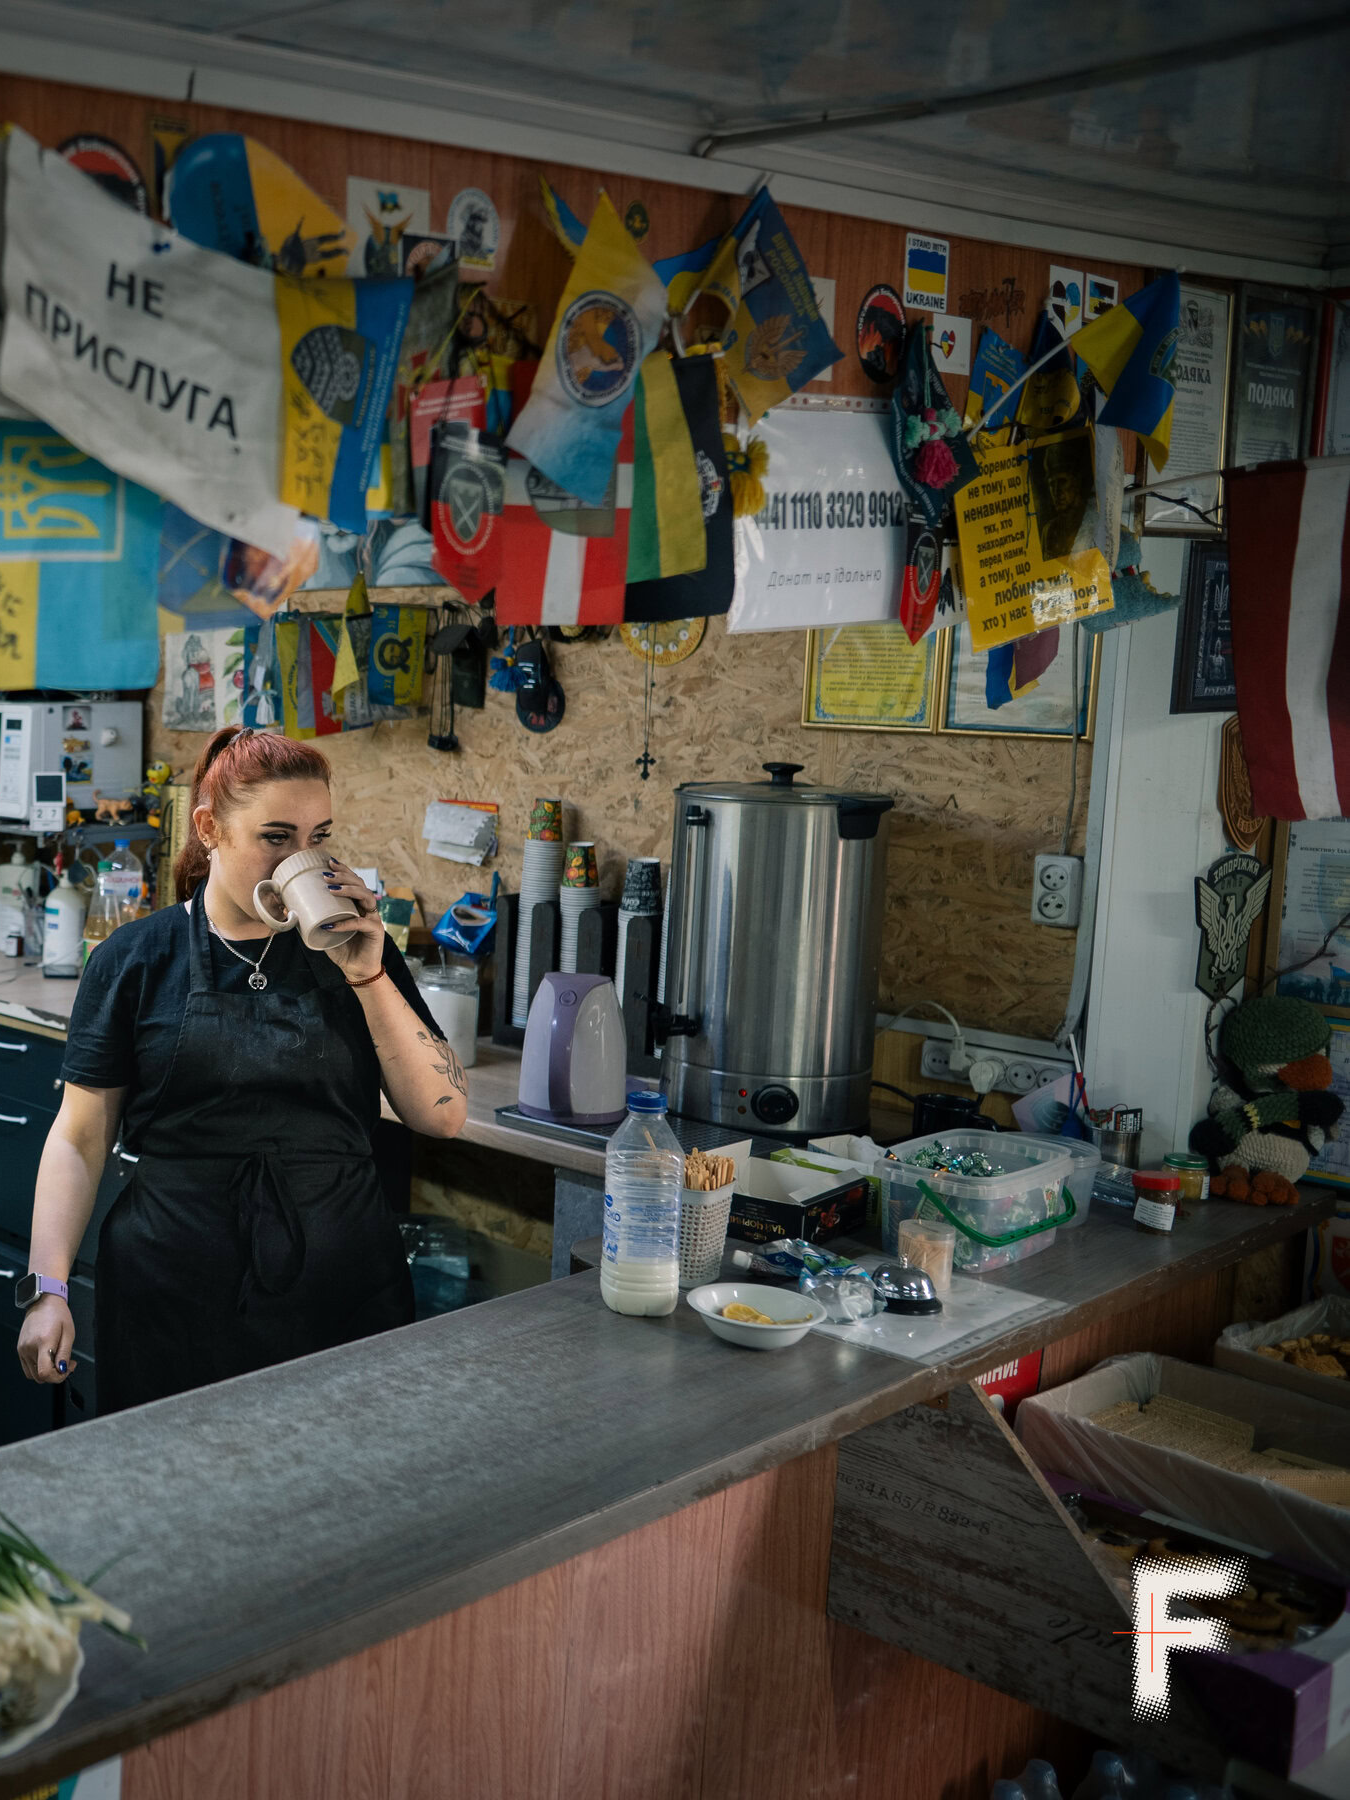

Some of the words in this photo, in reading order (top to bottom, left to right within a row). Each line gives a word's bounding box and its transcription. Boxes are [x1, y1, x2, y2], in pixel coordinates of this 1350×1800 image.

[106, 260, 164, 320] НЕ
[906, 291, 945, 310] UKRAINE
[24, 280, 238, 440] ПРИСЛУГА
[1176, 364, 1212, 386] ОДЯКА
[1247, 381, 1296, 409] ПОДЯКА
[967, 488, 980, 500] не
[981, 480, 1007, 496] тому,
[1007, 475, 1022, 488] що
[791, 491, 822, 529] 1110
[826, 491, 865, 528] 3329
[868, 490, 904, 527] 9912
[963, 493, 1030, 523] ненавидимо
[1000, 518, 1014, 530] хто
[976, 530, 1026, 553] знаходиться
[979, 553, 1003, 569] перед
[979, 576, 987, 588] а
[988, 570, 1014, 585] тому,
[1015, 561, 1032, 576] що
[982, 618, 1001, 632] хто
[1010, 605, 1028, 620] нас
[1213, 857, 1260, 884] ЗАПОРІЖЖЯ
